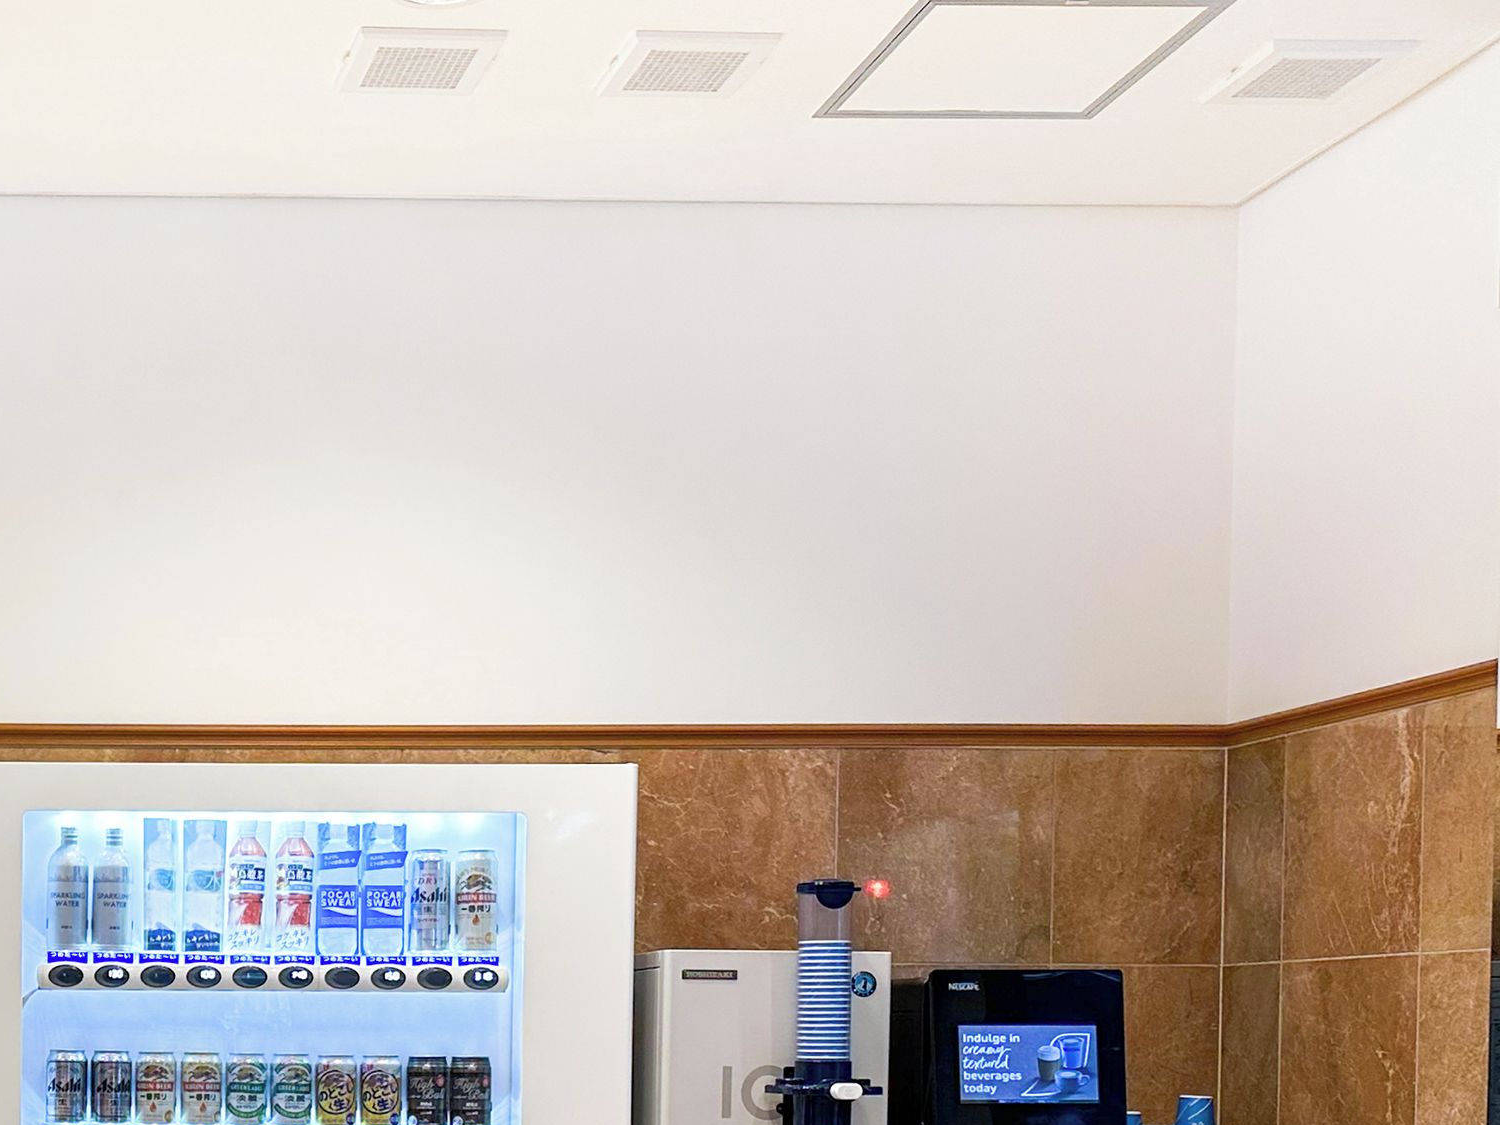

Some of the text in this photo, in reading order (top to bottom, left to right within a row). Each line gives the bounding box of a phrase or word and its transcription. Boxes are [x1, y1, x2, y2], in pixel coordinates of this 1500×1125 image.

[411, 886, 448, 904] Asahi
[56, 900, 79, 908] WATER
[103, 900, 127, 908] WATER
[321, 898, 356, 907] SWEAT
[367, 898, 402, 907] SWEAT
[460, 905, 491, 914] 一番搾り
[962, 1033, 1020, 1045] Indulge in
[962, 1045, 1011, 1064] creamy
[962, 1055, 1010, 1070] textured
[963, 1071, 1023, 1082] beverages
[47, 1078, 82, 1093] Asahi
[97, 1078, 131, 1093] Asahi
[410, 1077, 434, 1091] High
[453, 1077, 480, 1091] High
[964, 1083, 997, 1095] today
[140, 1093, 167, 1101] 一番搾り
[188, 1093, 216, 1101] 一番搾り
[319, 1084, 354, 1101] のどごし
[363, 1084, 399, 1101] のどごし
